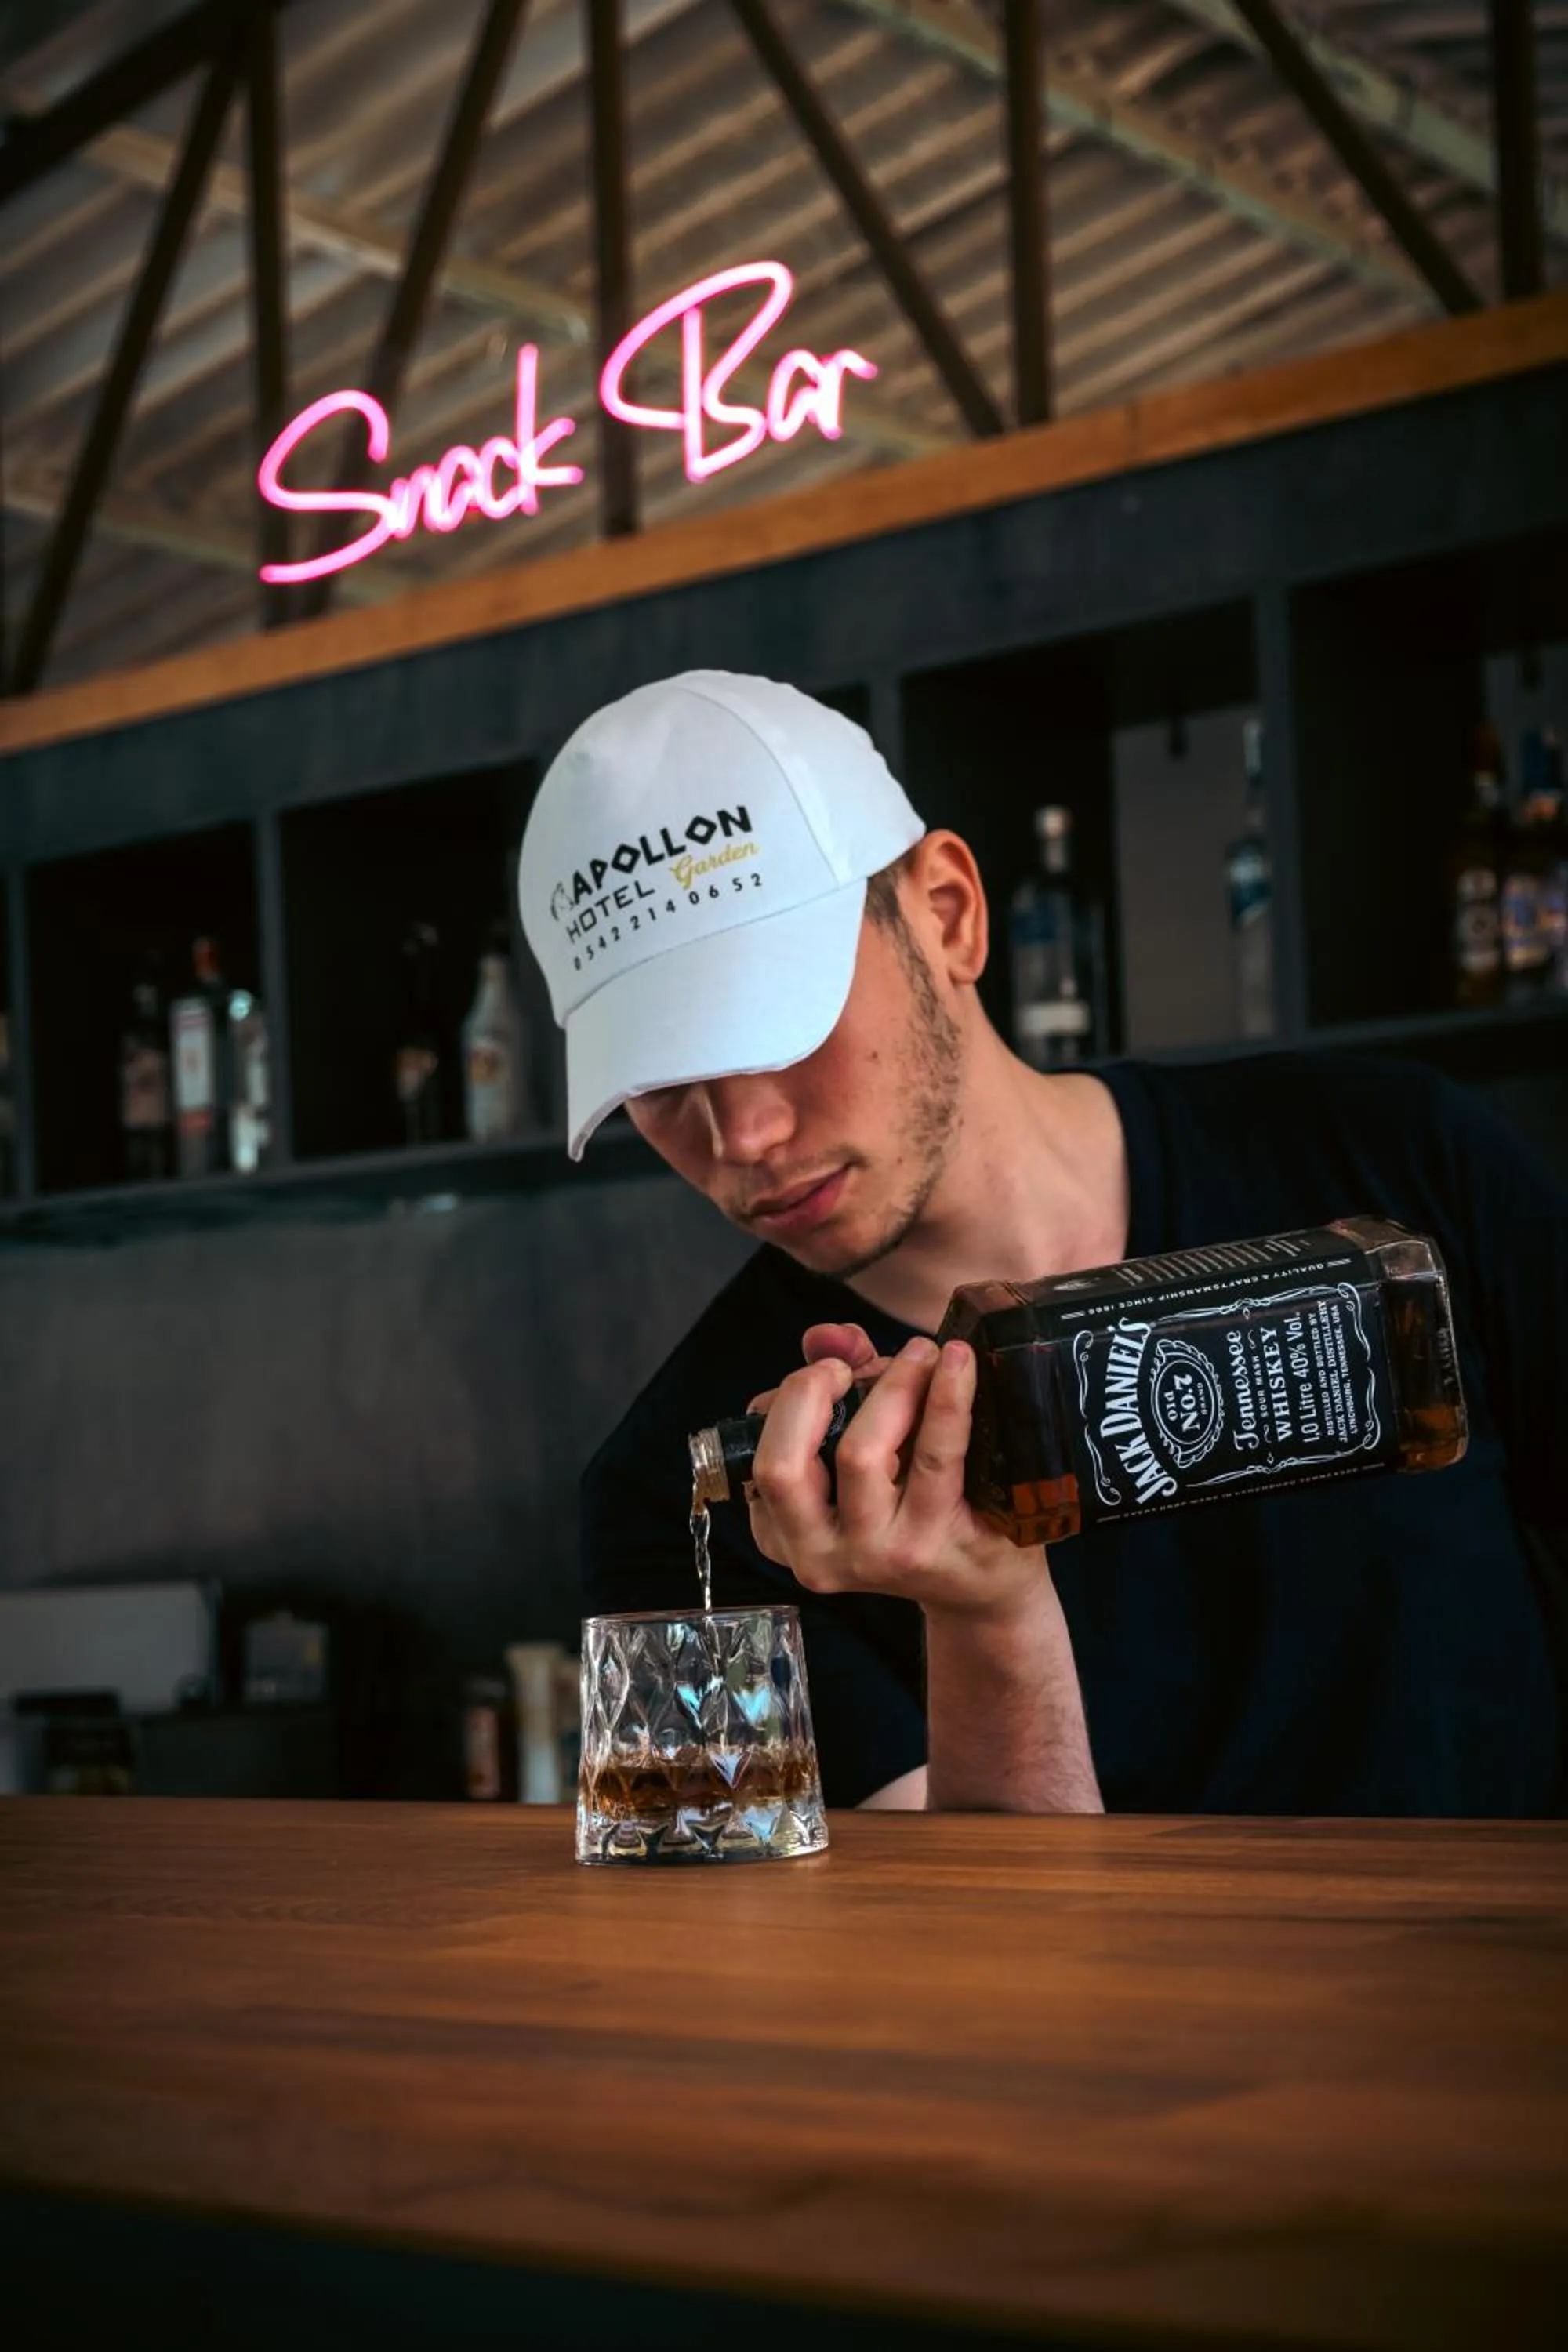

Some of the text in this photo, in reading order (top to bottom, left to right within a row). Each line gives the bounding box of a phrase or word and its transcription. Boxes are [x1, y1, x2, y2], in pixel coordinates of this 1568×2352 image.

[257, 260, 878, 583] Snack Bar
[566, 841, 759, 943] HOTEL Garden
[572, 805, 753, 904] APOLLON
[1273, 1263, 1324, 1278] QUALITY
[1330, 1305, 1340, 1323] USA
[1283, 1312, 1303, 1341] Vol.
[1289, 1343, 1309, 1377] 40%
[1308, 1313, 1334, 1435] DISTILLED AND BOTTLED BY
[1316, 1301, 1348, 1442] JACK DANIEL DISTILLERY
[1100, 1316, 1178, 1504] JACK DANIEL'S
[1164, 1391, 1178, 1421] Old
[1227, 1330, 1259, 1450] Tennessee
[1252, 1356, 1268, 1417] SOUR MASH
[1260, 1327, 1292, 1441] WHISKEY
[1299, 1383, 1316, 1419] Litre
